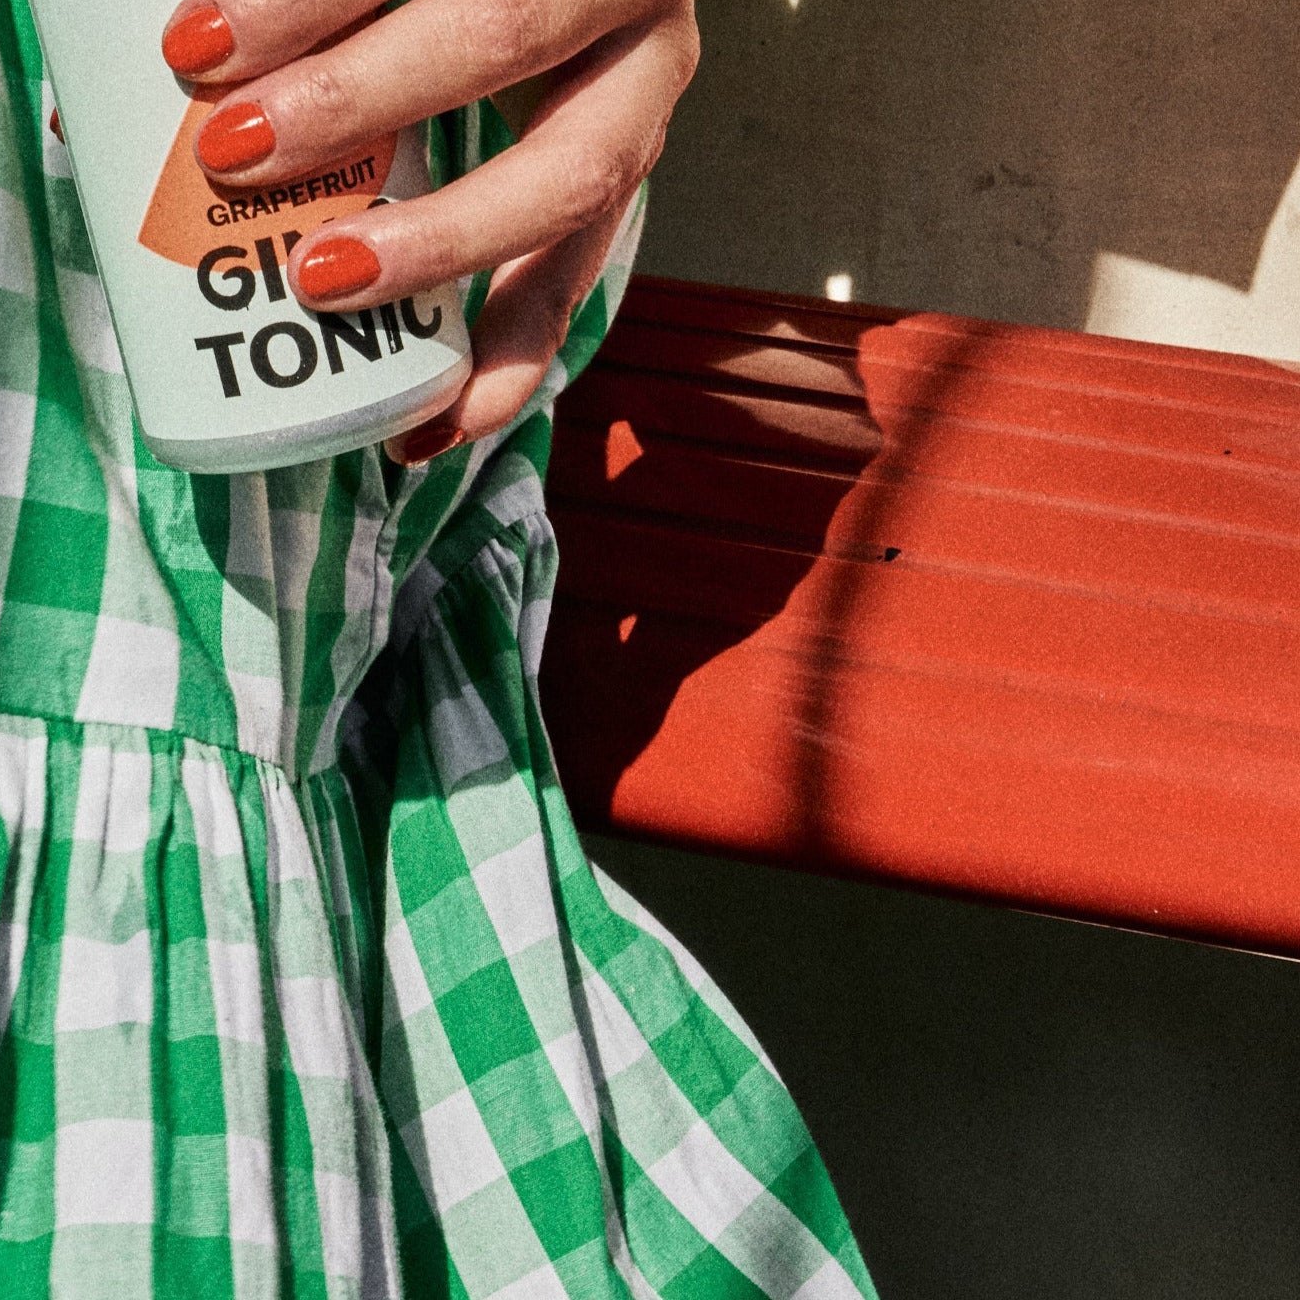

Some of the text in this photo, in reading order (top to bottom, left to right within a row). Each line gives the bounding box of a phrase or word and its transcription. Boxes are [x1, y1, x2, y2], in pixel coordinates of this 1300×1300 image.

[207, 156, 375, 226] GRAPEFRUIT
[197, 217, 335, 311] GI
[194, 297, 442, 399] TONIC
